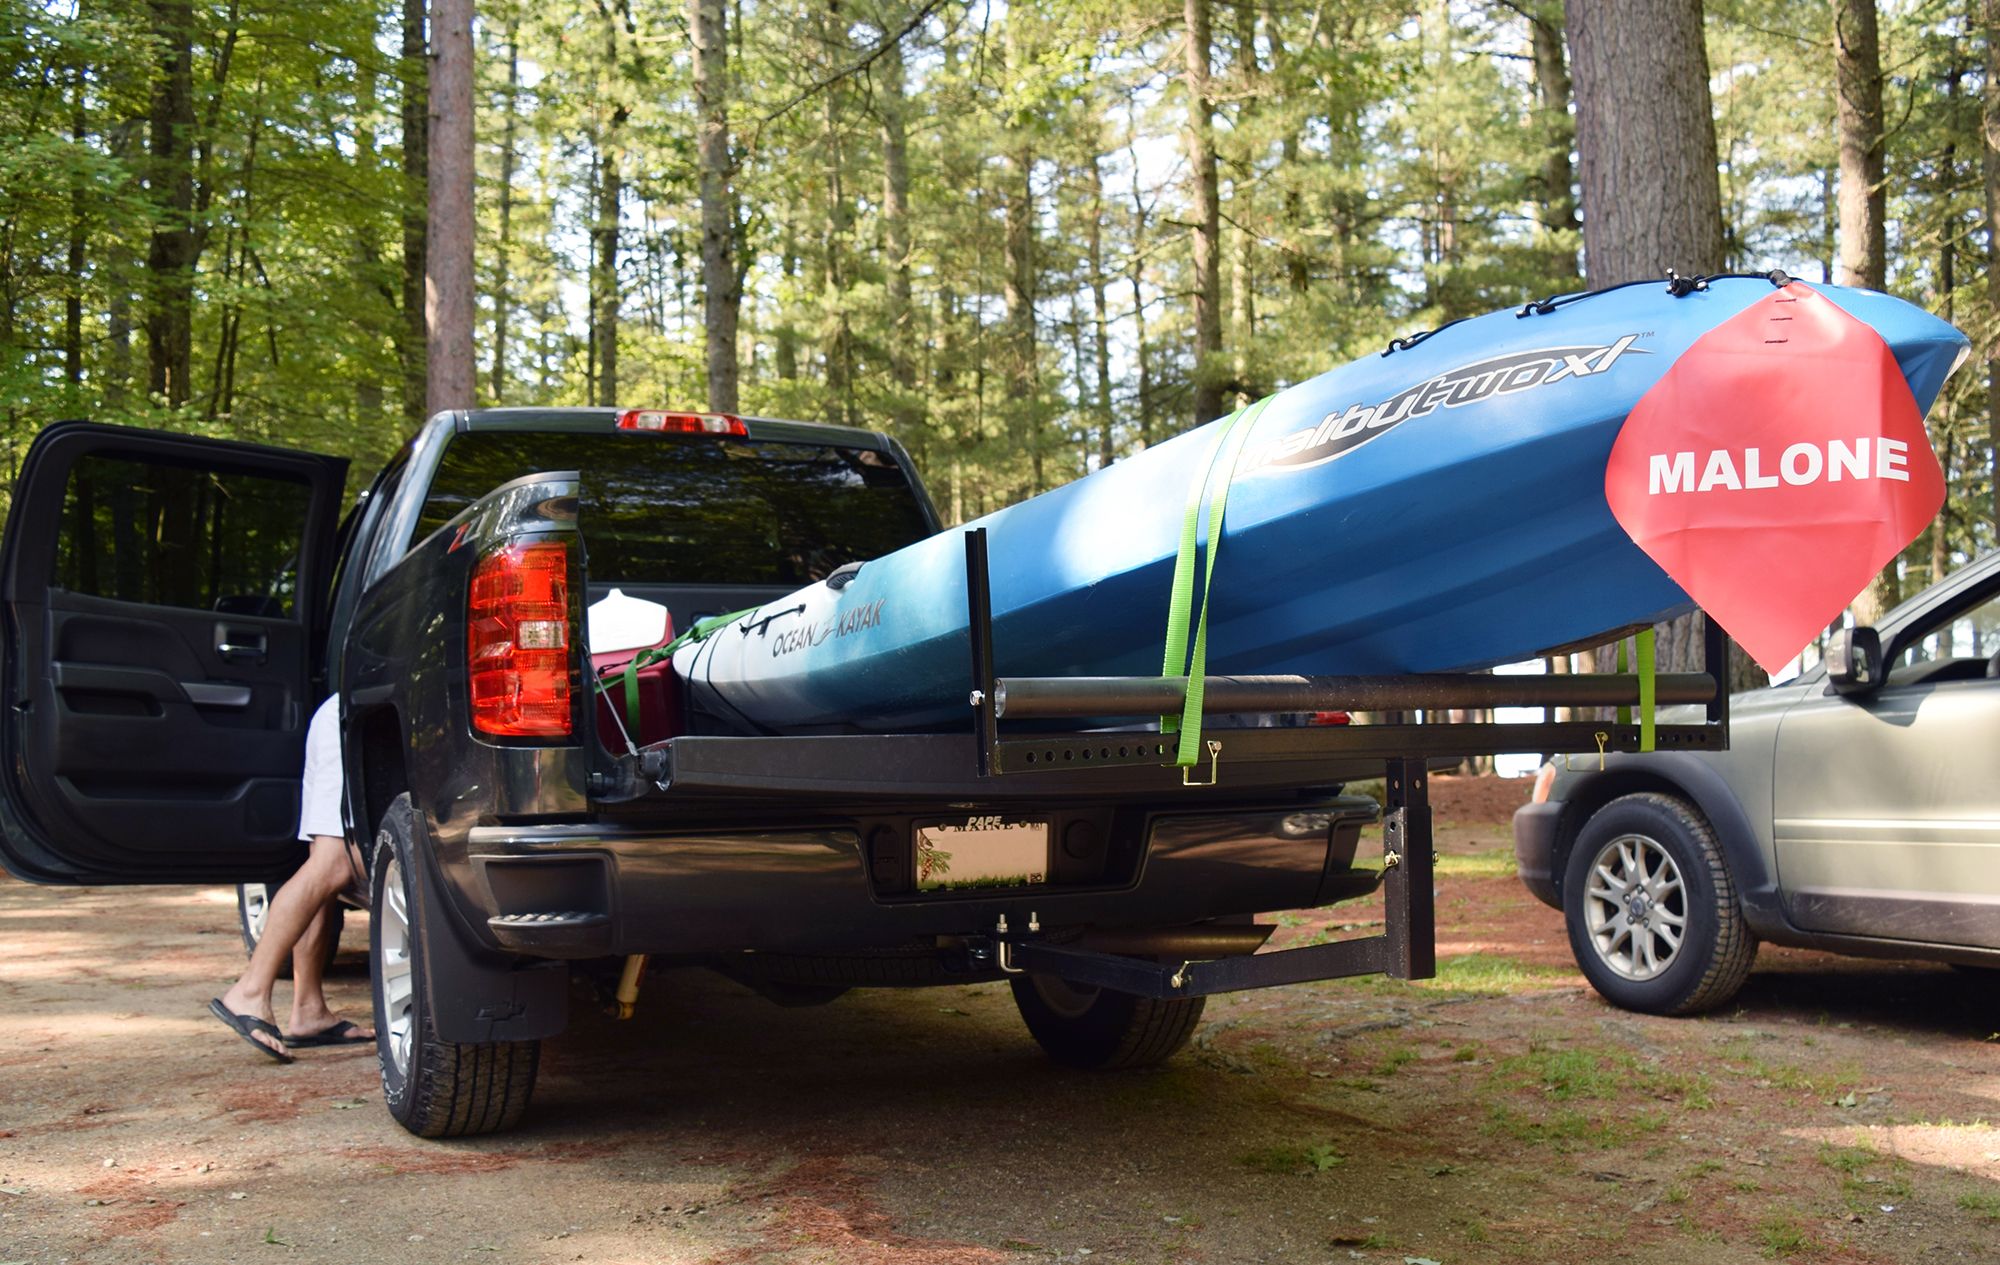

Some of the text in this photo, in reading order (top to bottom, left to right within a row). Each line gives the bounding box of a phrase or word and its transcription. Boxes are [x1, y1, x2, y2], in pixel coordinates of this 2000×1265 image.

[1649, 437, 1909, 495] MALONE
[773, 598, 887, 657] OCEAN KAYAK
[967, 816, 1002, 826] PAPE
